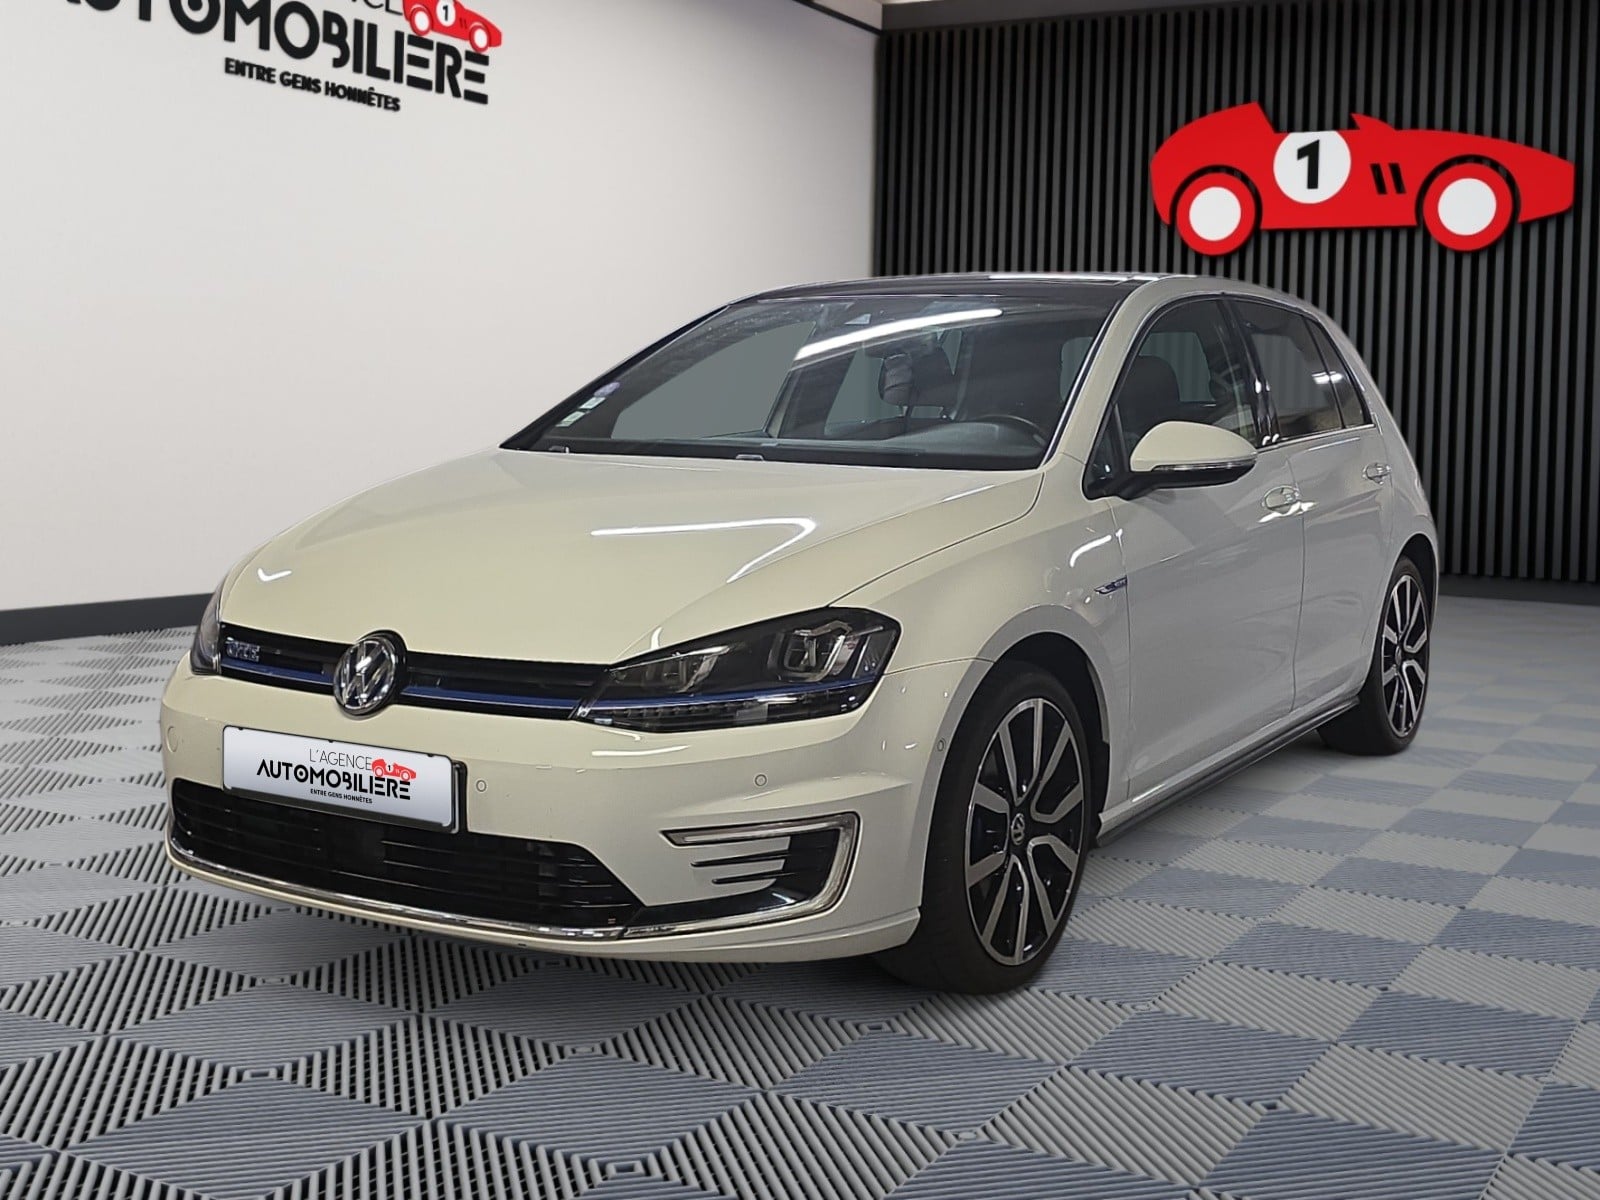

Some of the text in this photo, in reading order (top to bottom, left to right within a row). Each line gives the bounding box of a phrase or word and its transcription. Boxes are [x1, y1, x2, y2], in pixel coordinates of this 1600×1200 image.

[225, 57, 401, 112] ENTRE GENS HONNÊTES
[1296, 139, 1320, 190] 1
[256, 758, 411, 800] AUTOMOBILIERE
[309, 748, 373, 771] L'AGENCE
[310, 788, 327, 796] ENTRE
